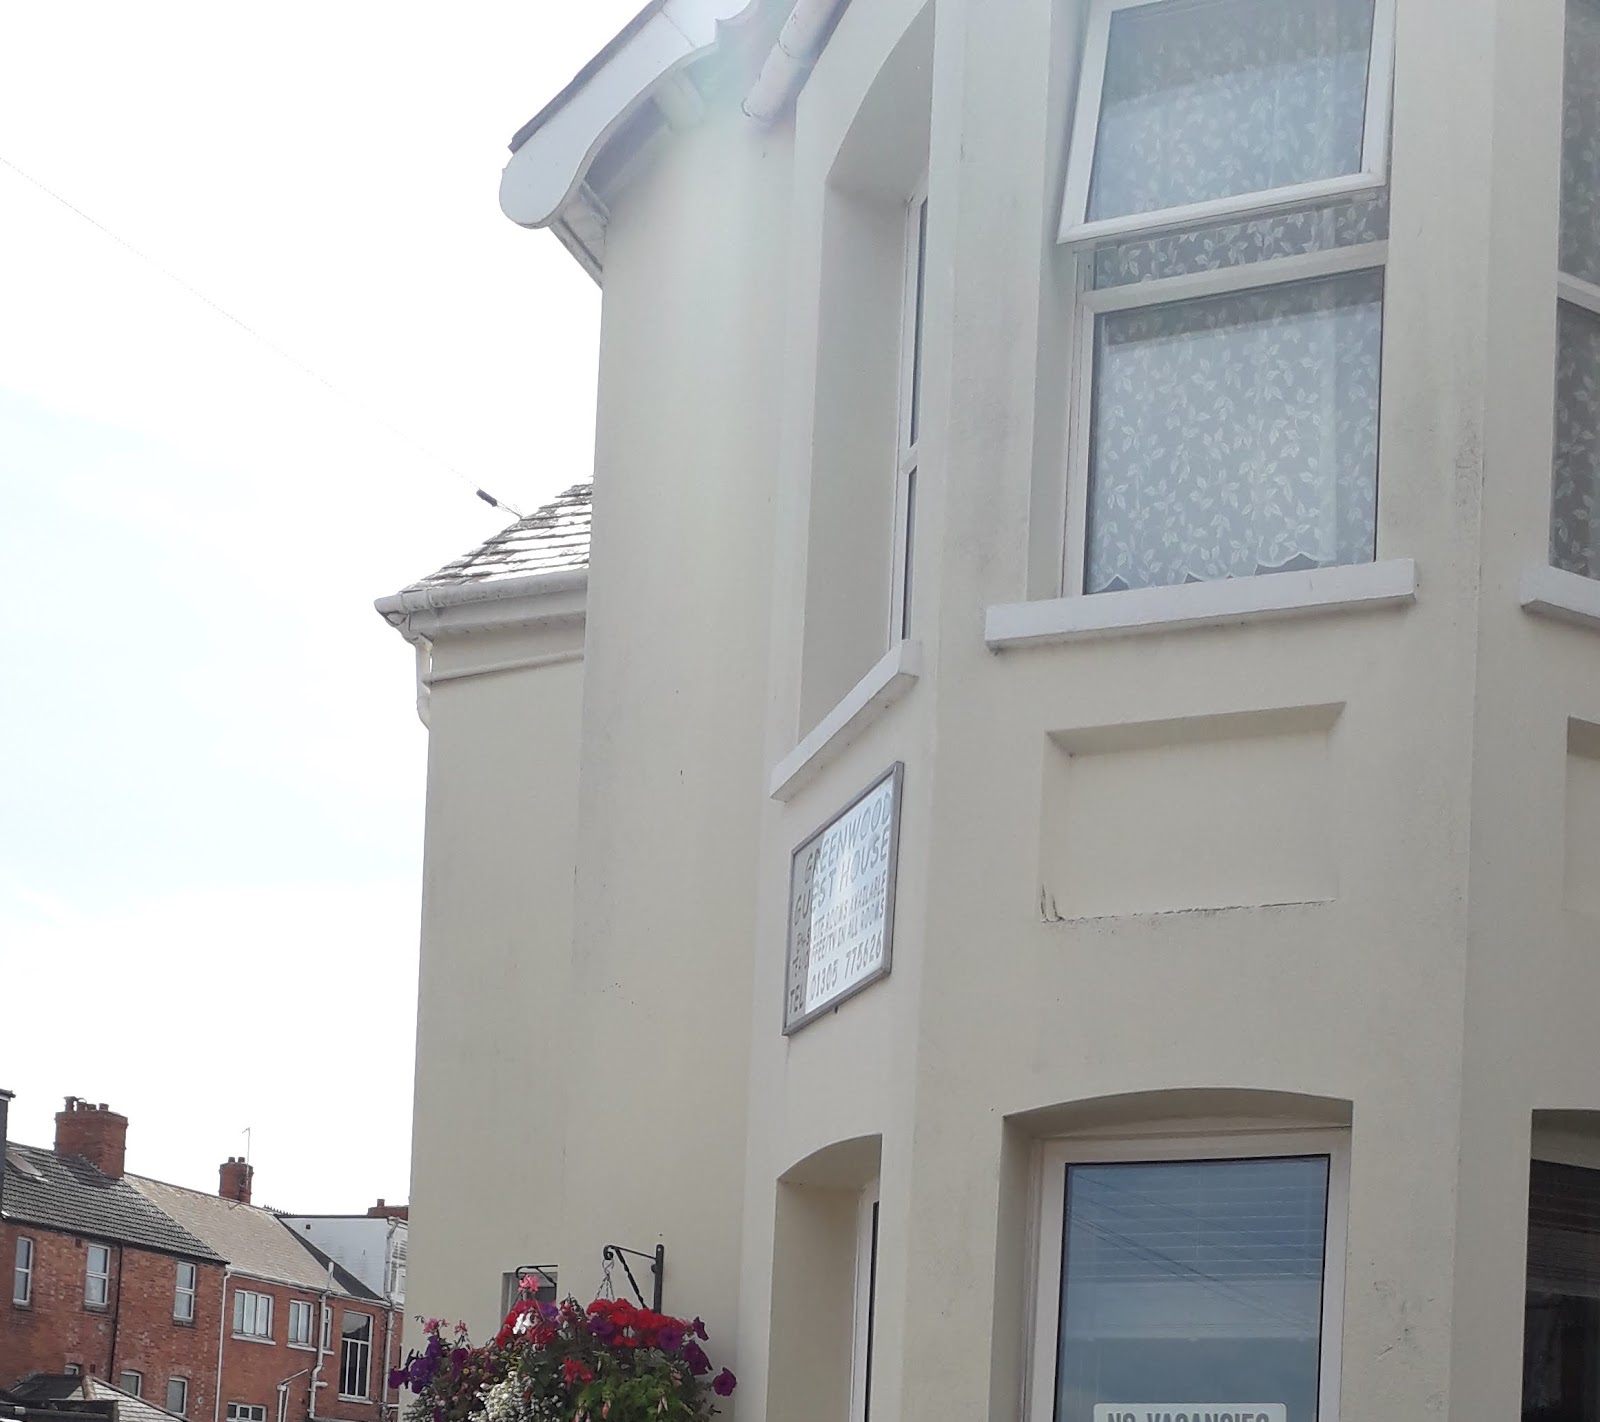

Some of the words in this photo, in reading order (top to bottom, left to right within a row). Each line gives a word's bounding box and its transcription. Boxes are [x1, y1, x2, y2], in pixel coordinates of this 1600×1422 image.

[794, 872, 836, 925] GUEST
[839, 824, 889, 892] HOUSE
[805, 792, 891, 884] GREENWOOD
[810, 957, 838, 1002] 01305
[844, 928, 882, 980] 775626
